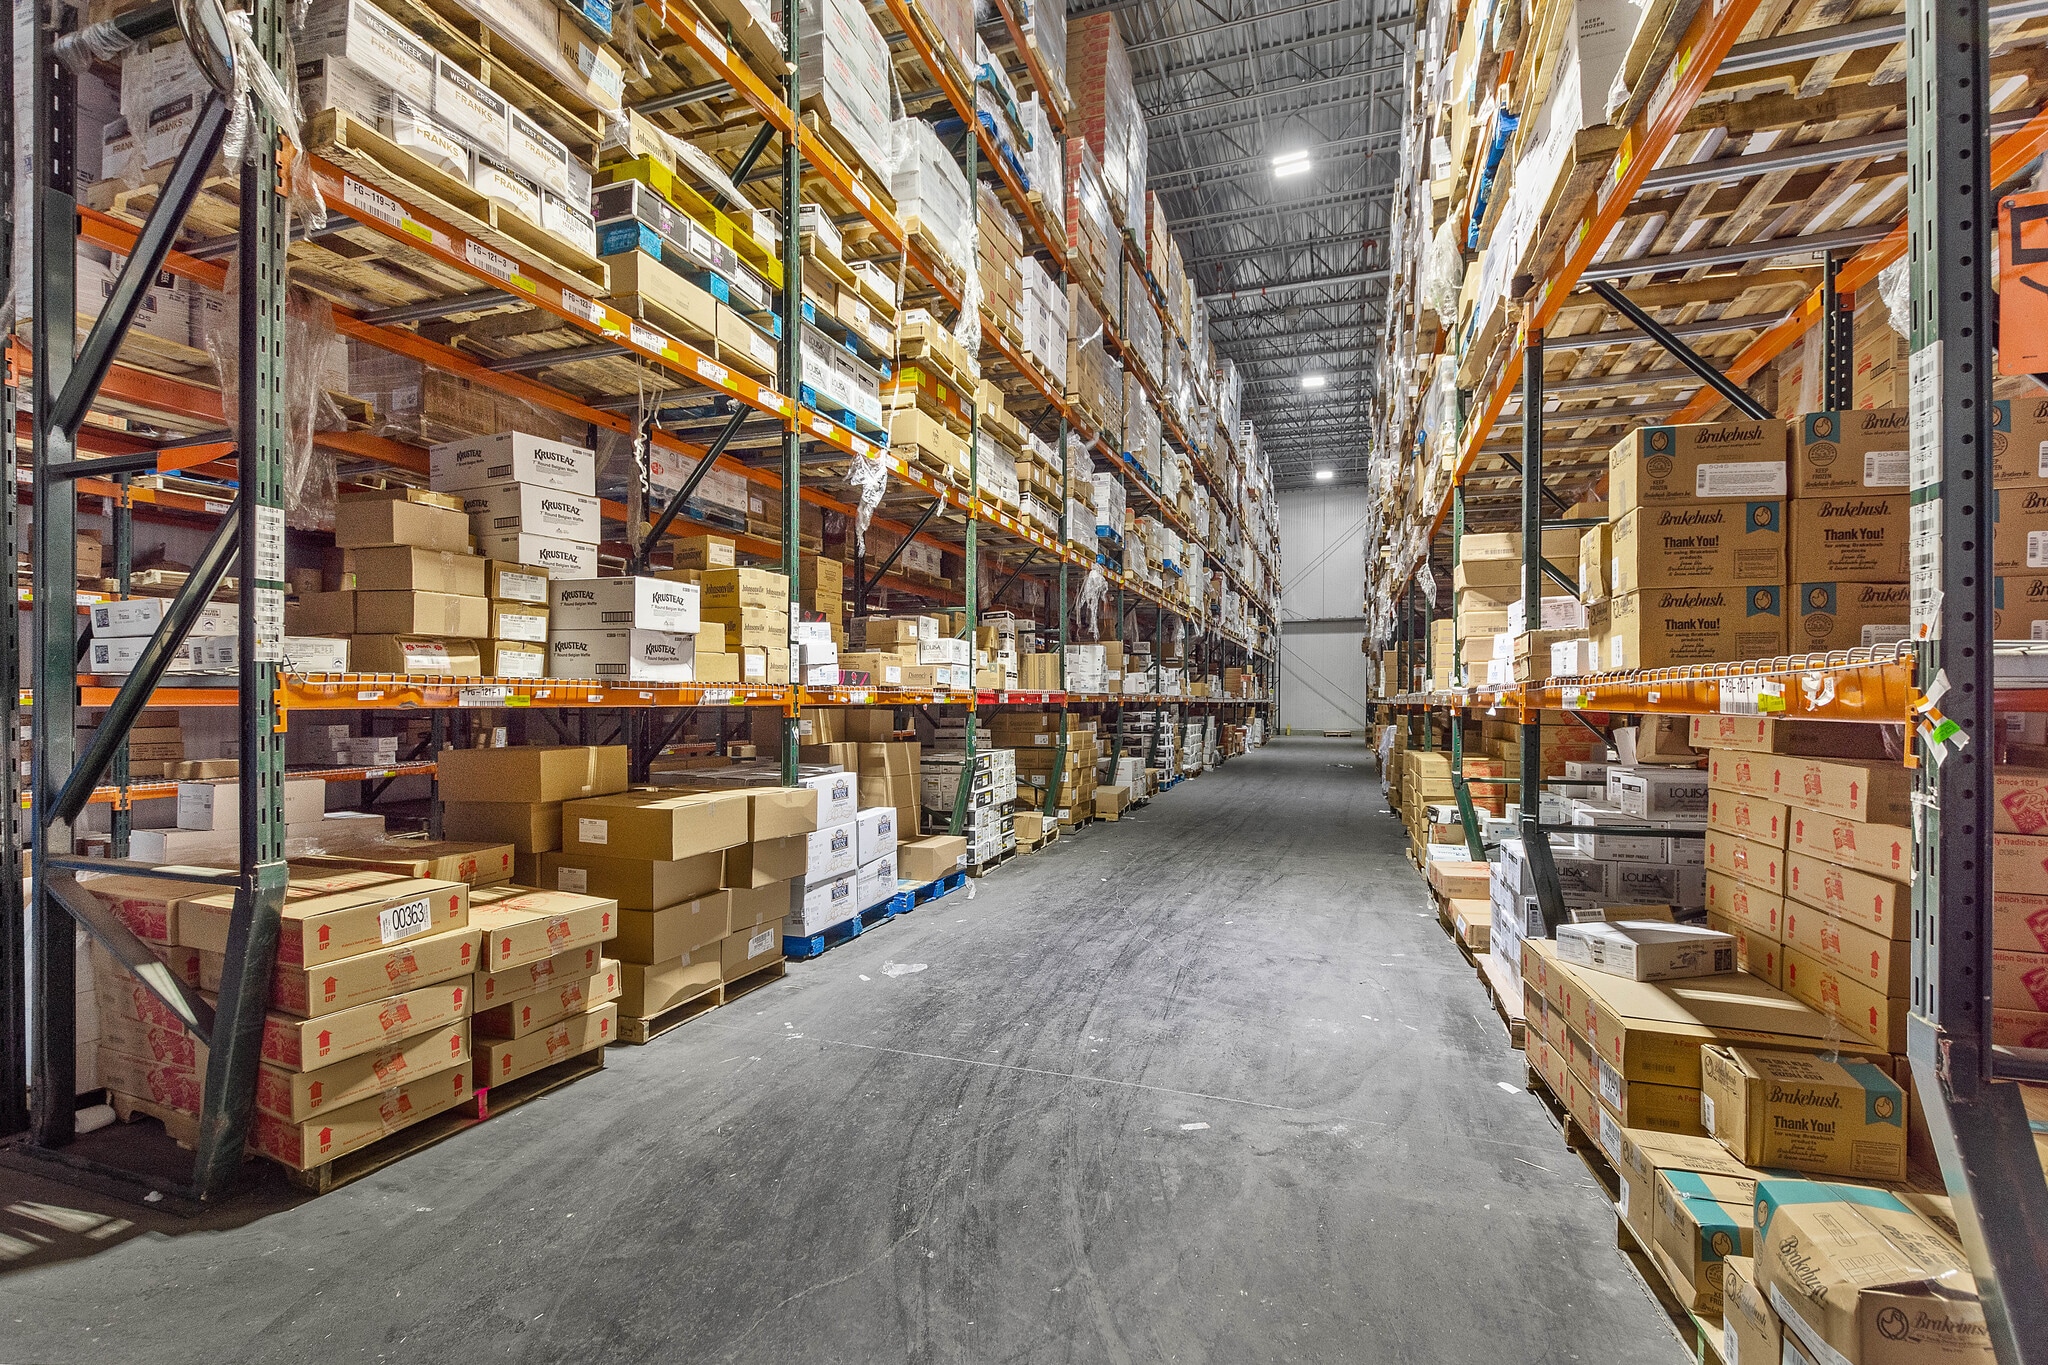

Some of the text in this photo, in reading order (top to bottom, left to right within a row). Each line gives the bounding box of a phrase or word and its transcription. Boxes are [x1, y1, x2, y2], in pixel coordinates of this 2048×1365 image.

[1581, 21, 1605, 30] FROZEN
[366, 14, 422, 61] WEST CREEK
[371, 36, 417, 73] FRANKS
[564, 42, 579, 65] HUS
[449, 71, 498, 110] WEST CREEK
[455, 90, 493, 123] FRANKS
[156, 119, 183, 136] FRANKS
[417, 127, 459, 157] FRANKS
[520, 122, 560, 157] WEST CREEK
[112, 141, 133, 154] FRANK
[525, 140, 557, 168] FRANKS
[513, 172, 533, 191] CREEK
[494, 174, 529, 202] FRANKS
[353, 183, 396, 212] FG-119-3
[473, 244, 507, 268] FG-121-3
[1861, 412, 1910, 430] Brakeb
[1694, 425, 1762, 444] Brakebush
[456, 450, 482, 462] KRUSTEAZ
[534, 449, 575, 467] KRUSTEAZ
[464, 500, 488, 511] KRUSTEAZ
[541, 500, 581, 516] KRUSTEAZ
[1818, 501, 1888, 517] Brakebush
[1657, 509, 1723, 526] Brakebush
[1824, 528, 1884, 540] Thank You!
[1663, 535, 1719, 548] Thank You!
[539, 548, 579, 563] KRUSTEAZ
[704, 584, 735, 595] Johnsonville
[741, 585, 764, 593] Johnsonville
[766, 587, 786, 596] Johnsonville
[561, 590, 595, 601] KRUSTEAZ
[652, 592, 684, 606] KRUSTEAZ
[1658, 592, 1723, 608] Brakebush
[744, 624, 765, 633] Johnsonville
[768, 625, 786, 635] Johnsonville
[1665, 618, 1720, 630] Thank You!
[554, 641, 588, 652] KRUSTEAZ
[645, 643, 676, 655] KRUSTEAZ
[769, 662, 788, 671] Johnsonville
[467, 688, 500, 696] FG-121-1
[1670, 788, 1709, 798] LOUISA
[2004, 838, 2035, 846] Tradition
[1622, 873, 1660, 882] LOUISA
[2022, 896, 2042, 905] Since
[392, 902, 425, 931] 00363
[449, 909, 458, 918] UP
[319, 942, 330, 951] UP
[461, 957, 470, 966] UP
[2016, 955, 2037, 964] Since
[325, 994, 336, 1003] UP
[454, 1003, 463, 1011] UP
[2016, 1017, 2037, 1026] Since
[319, 1048, 330, 1057] UP
[452, 1049, 460, 1058] UP
[503, 1068, 511, 1076] UP
[454, 1088, 463, 1097] UP
[1767, 1086, 1840, 1109] Brakebush
[311, 1099, 322, 1108] UP
[1774, 1116, 1835, 1133] Thank You!
[320, 1144, 331, 1154] UP
[1914, 1311, 1989, 1336] Brakebus
